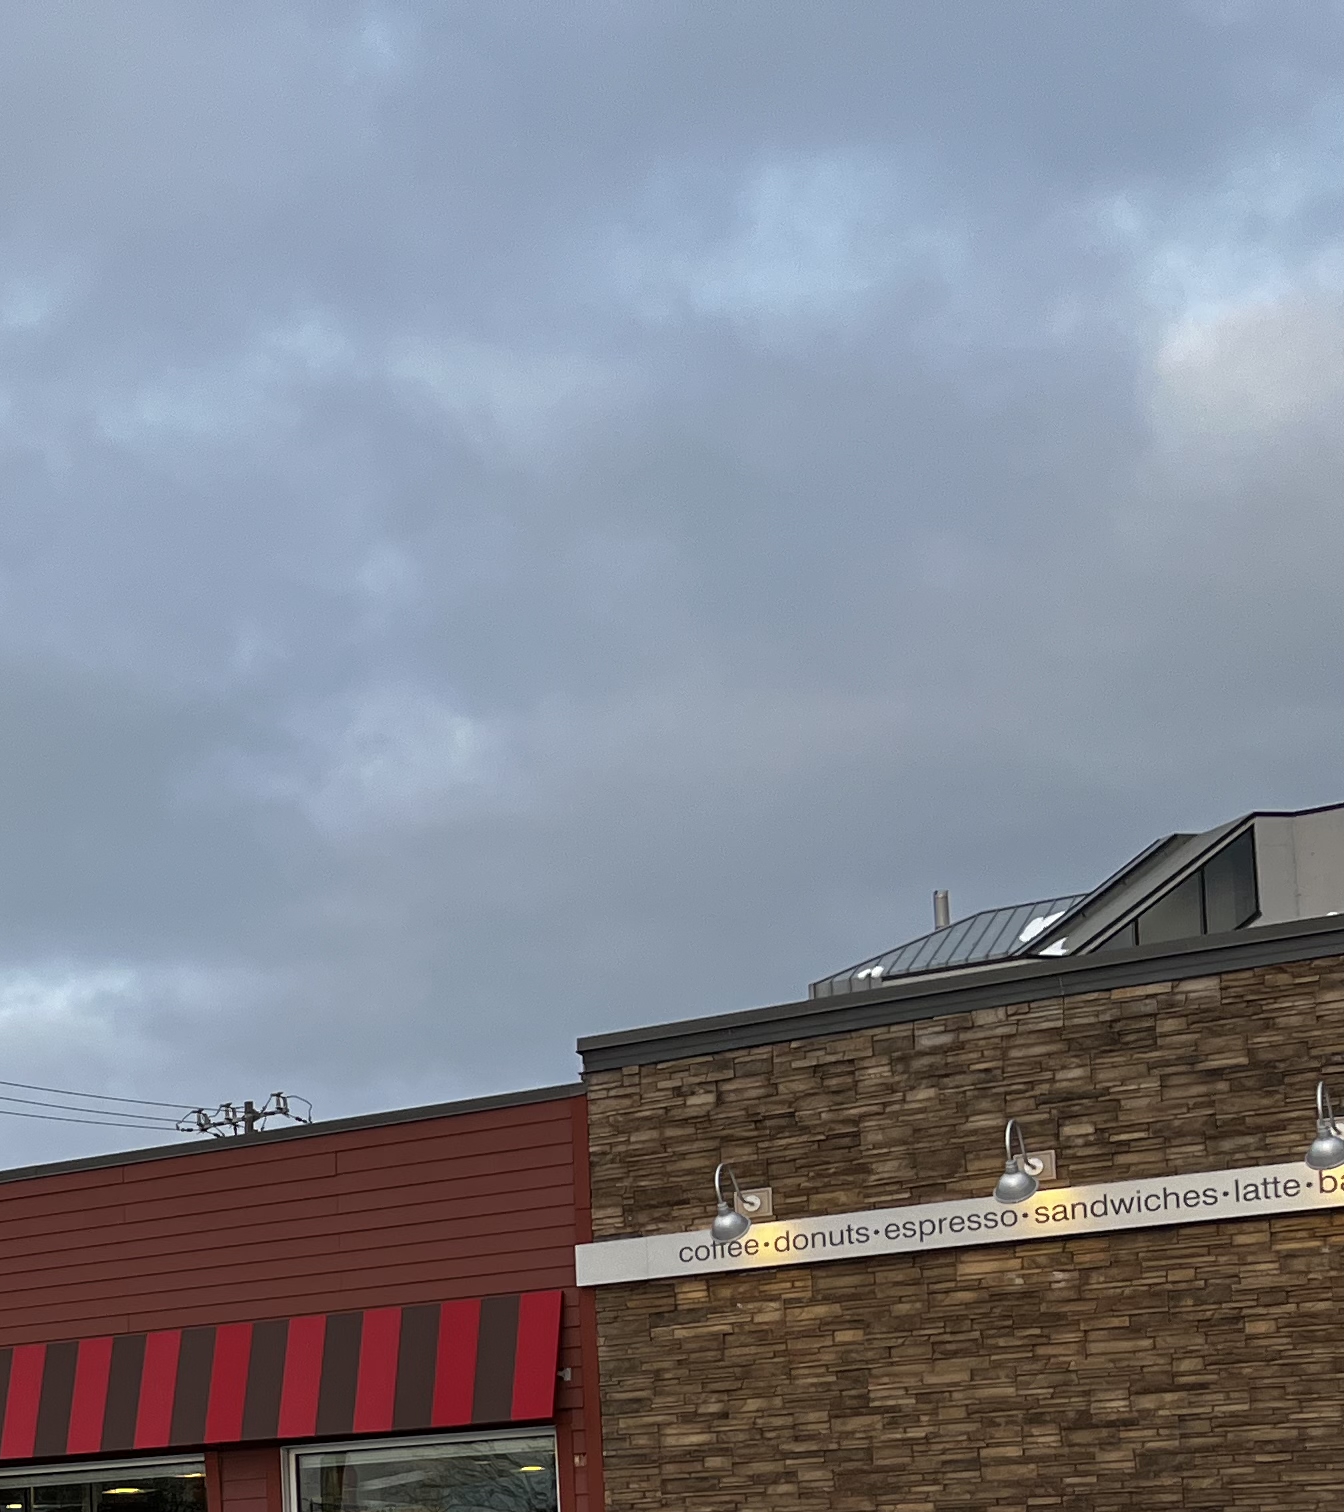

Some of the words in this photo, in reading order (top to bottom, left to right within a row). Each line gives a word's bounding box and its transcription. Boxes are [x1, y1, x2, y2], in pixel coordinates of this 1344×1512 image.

[773, 1225, 870, 1253] donuts
[883, 1209, 1018, 1243] espresso
[1034, 1186, 1219, 1223] sandwiches
[1234, 1175, 1301, 1203] latte
